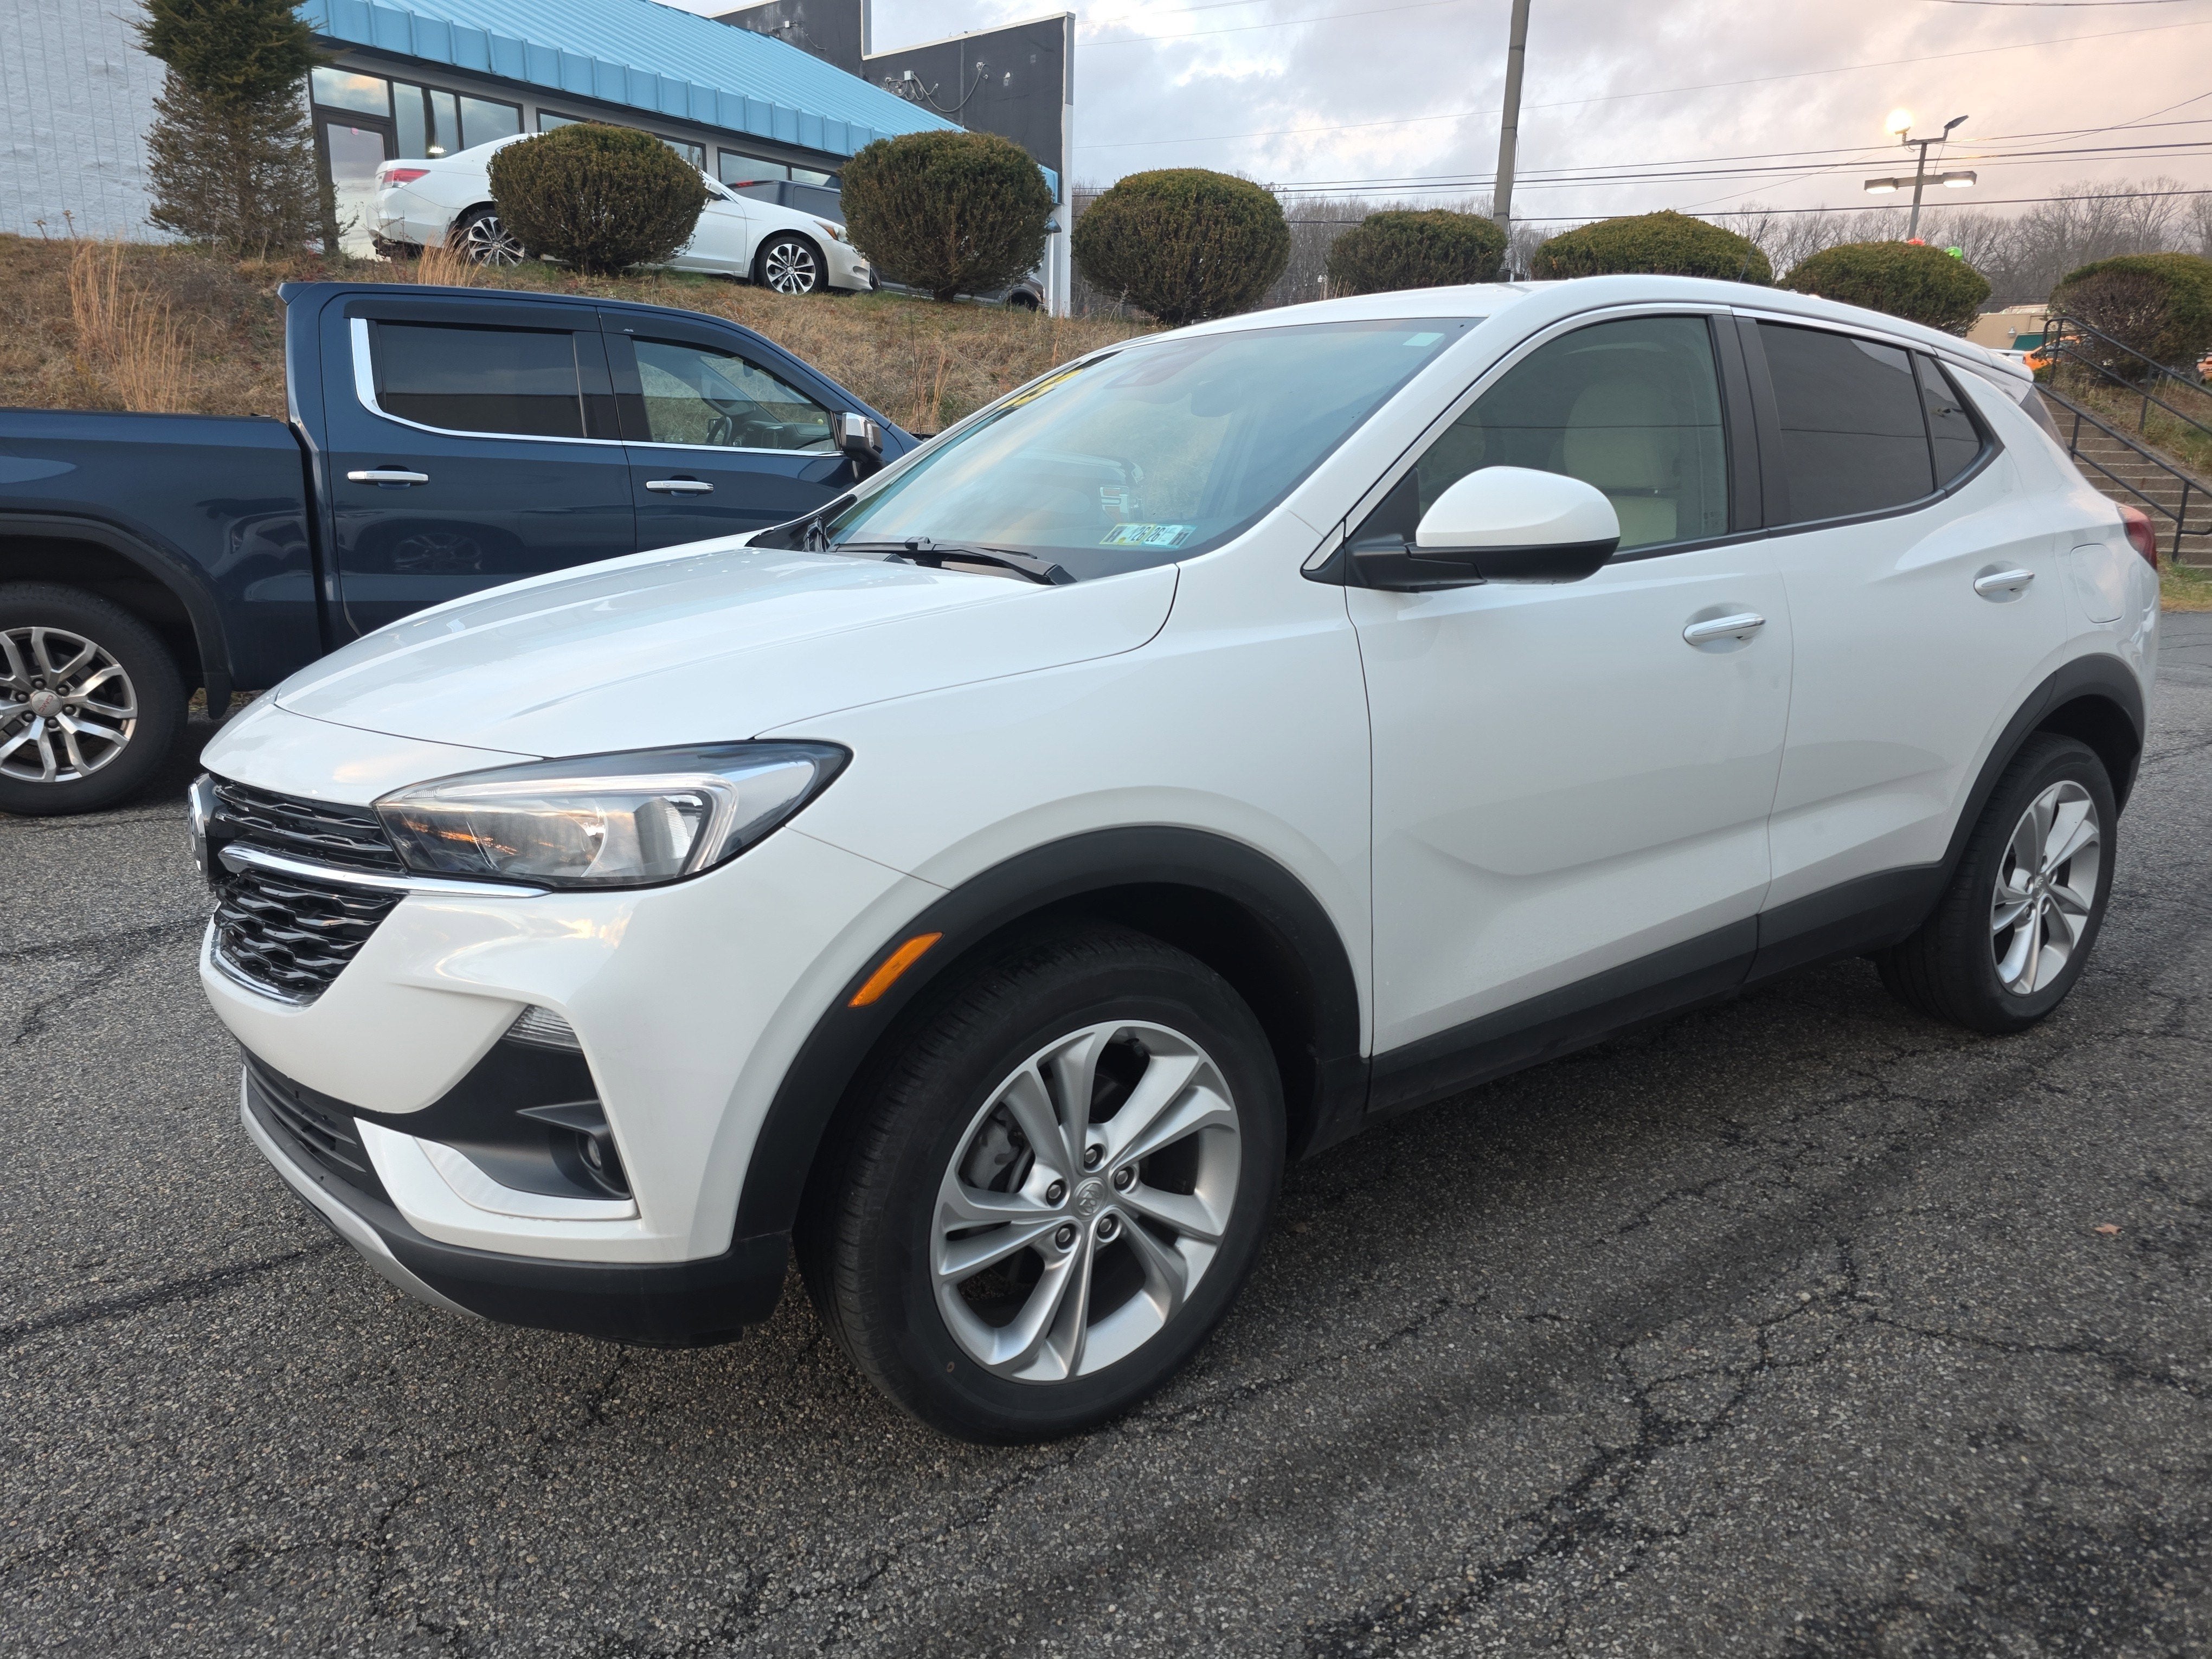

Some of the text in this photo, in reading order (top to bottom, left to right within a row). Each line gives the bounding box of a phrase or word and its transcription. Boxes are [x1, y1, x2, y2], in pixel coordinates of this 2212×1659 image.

[1130, 526, 1151, 542] 26
[1145, 527, 1166, 542] 26
[1169, 531, 1189, 545] 11
[38, 695, 53, 712] GMC
